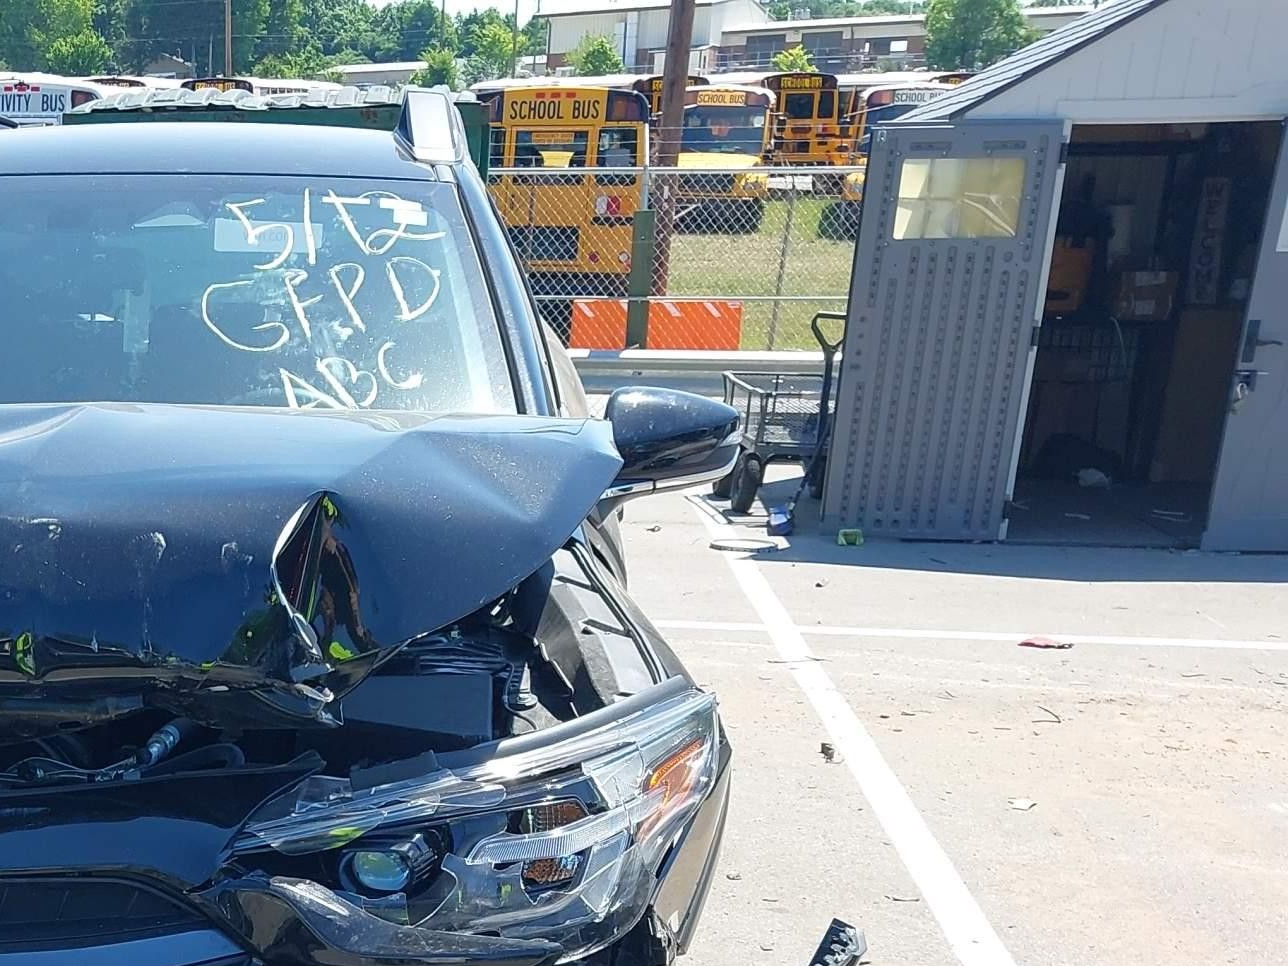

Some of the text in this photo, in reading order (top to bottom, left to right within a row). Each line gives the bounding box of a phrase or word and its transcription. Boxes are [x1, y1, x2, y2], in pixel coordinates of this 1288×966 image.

[41, 93, 65, 112] BUS
[697, 94, 745, 105] SCHOOL BUS
[895, 92, 927, 103] SCHOOL
[509, 99, 600, 120] SCHOOL BUS
